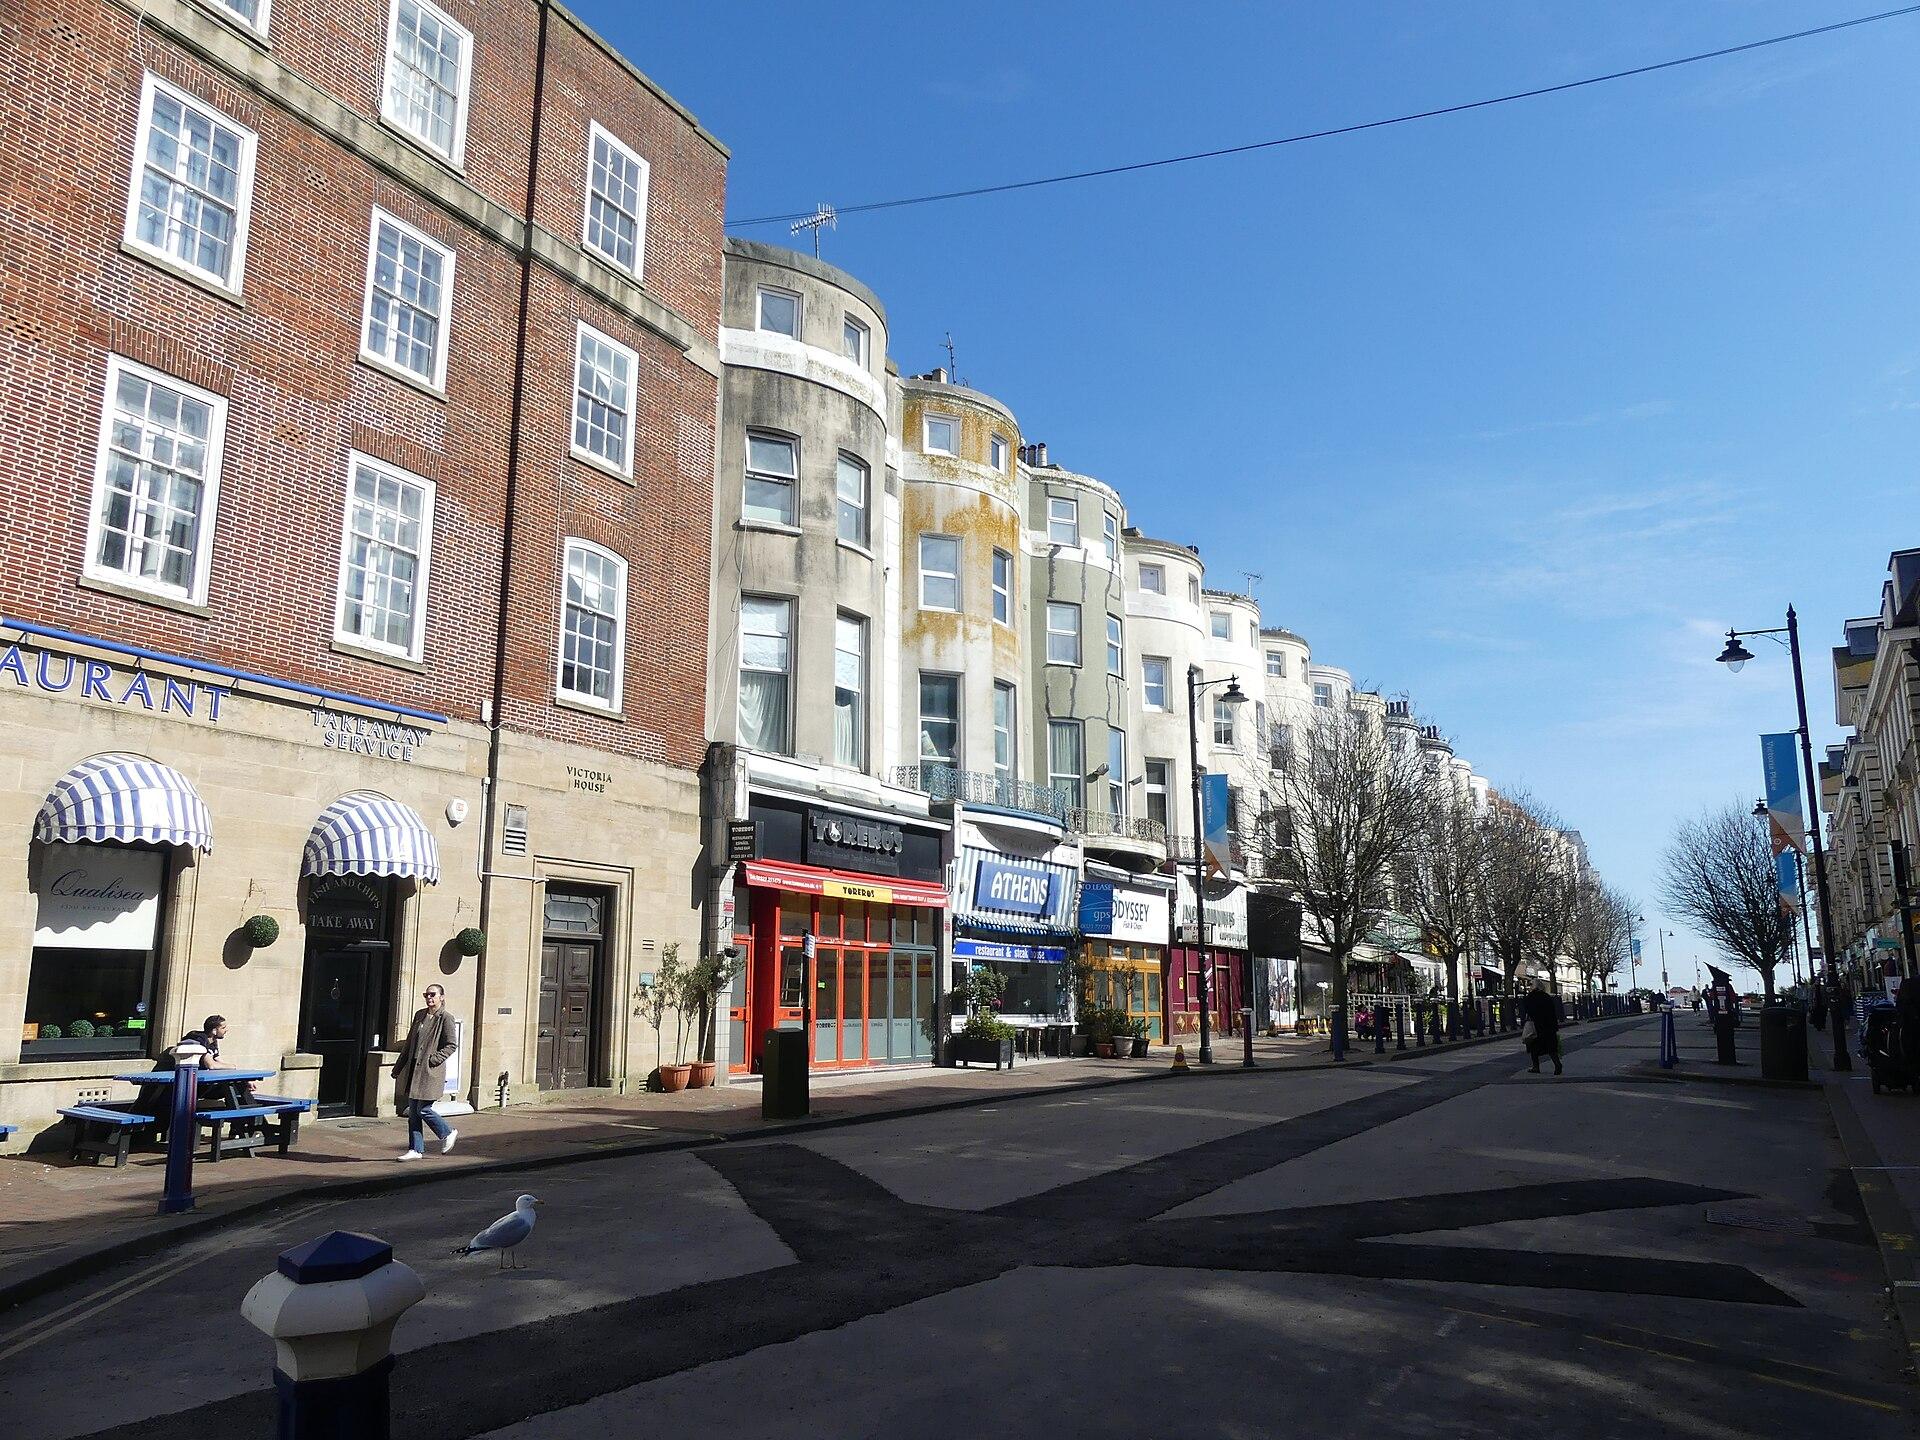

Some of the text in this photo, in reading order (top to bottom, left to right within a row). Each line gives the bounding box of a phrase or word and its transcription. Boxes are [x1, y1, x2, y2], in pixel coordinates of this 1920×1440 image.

[0, 645, 231, 722] AURANT
[312, 708, 428, 747] TAKEAWAY
[324, 729, 414, 762] SERVICE
[566, 766, 612, 783] VICTORIA
[574, 779, 605, 793] HOUSE
[813, 816, 903, 853] TOREROS
[51, 868, 145, 901] Qualisea
[309, 877, 380, 909] FISH AND CHIPS
[842, 886, 875, 898] TOREROS
[991, 871, 1049, 906] ATHENS
[309, 915, 377, 930] TAKE AWAY
[1093, 911, 1111, 921] gps
[975, 945, 1005, 957] restaurant
